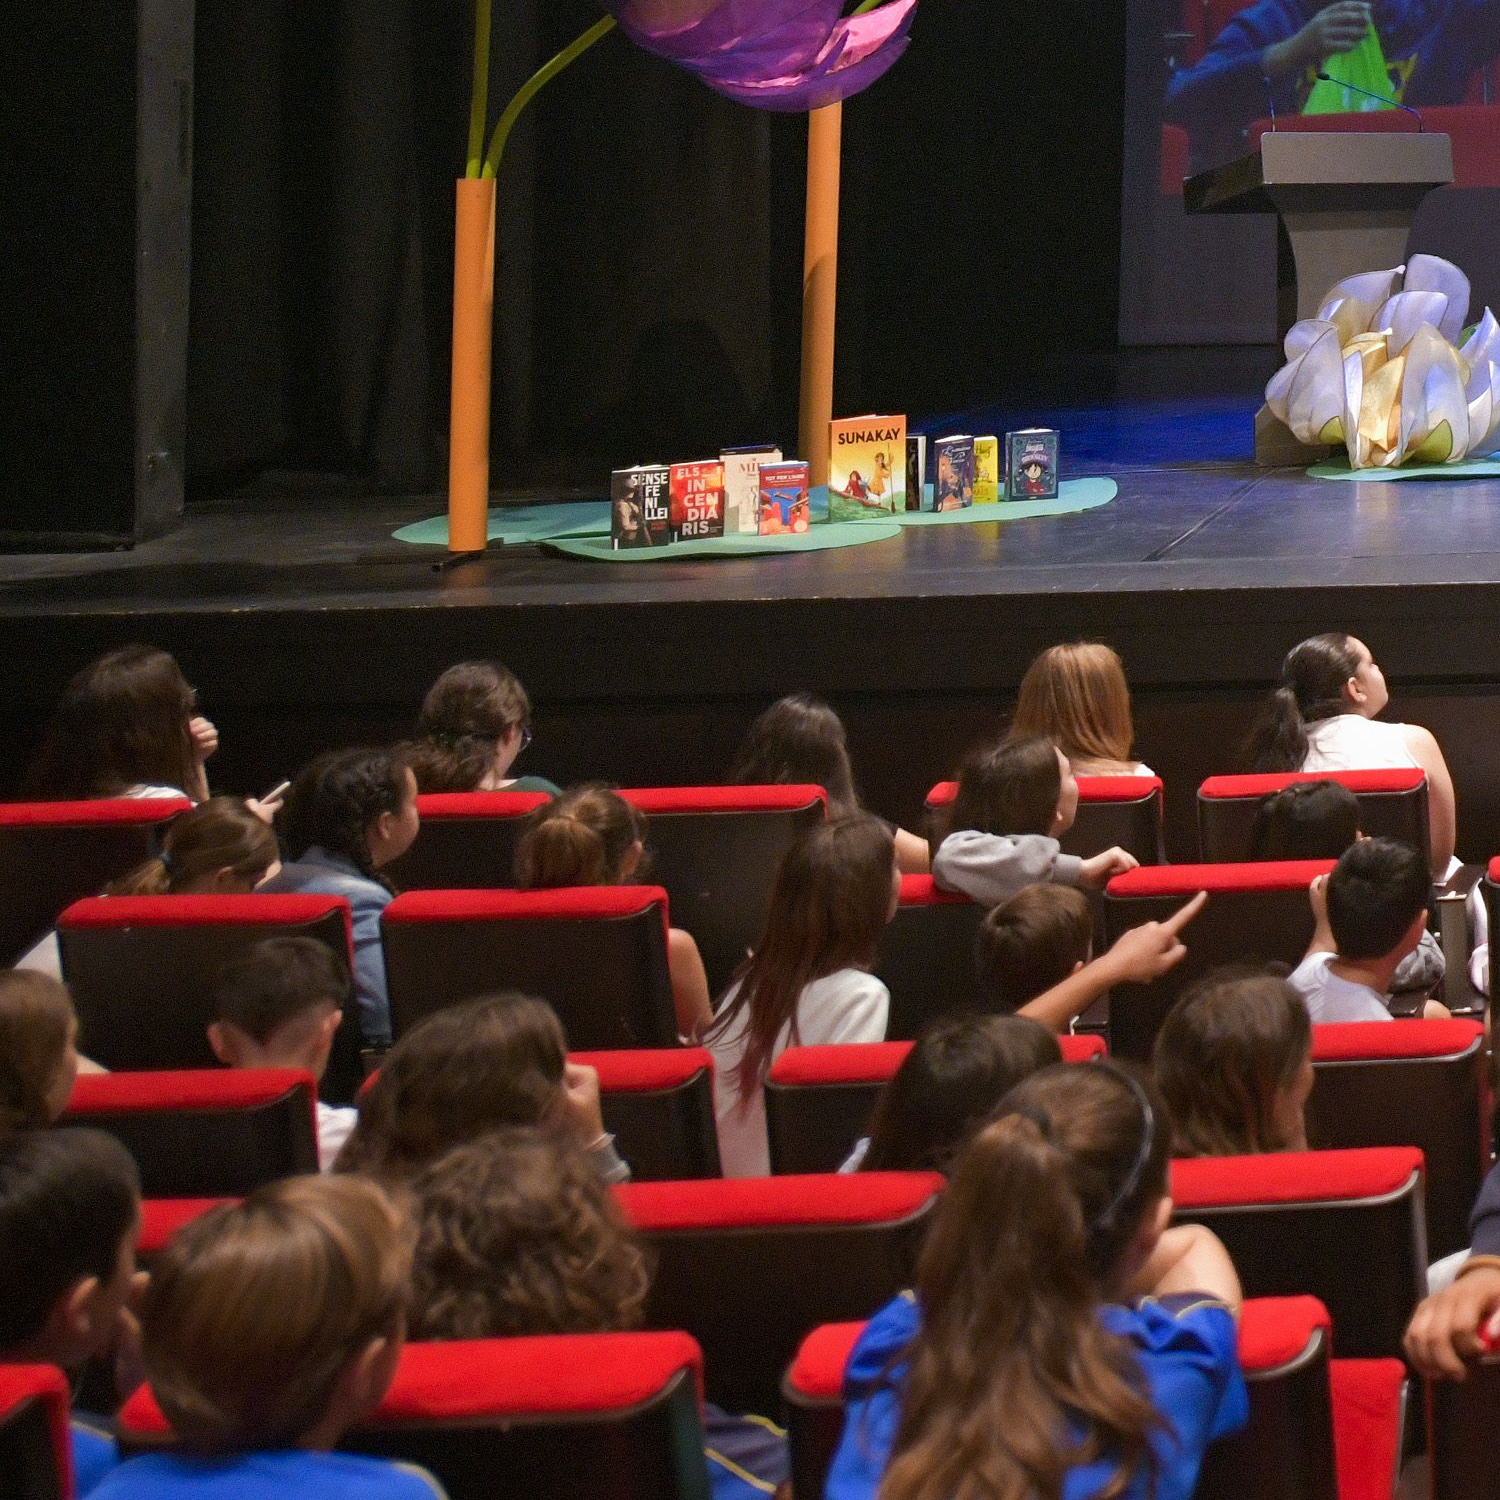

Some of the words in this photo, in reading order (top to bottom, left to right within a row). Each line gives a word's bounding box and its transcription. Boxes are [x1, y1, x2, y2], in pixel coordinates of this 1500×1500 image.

[838, 428, 901, 445] SUNAKAY
[630, 472, 669, 486] SENSE
[677, 467, 700, 478] ELS
[645, 485, 661, 497] FE
[687, 479, 706, 493] IN
[645, 497, 658, 509] NI
[683, 492, 719, 507] CEN
[645, 507, 668, 520] LLEI
[687, 506, 719, 521] DIA
[681, 520, 709, 536] RIS
